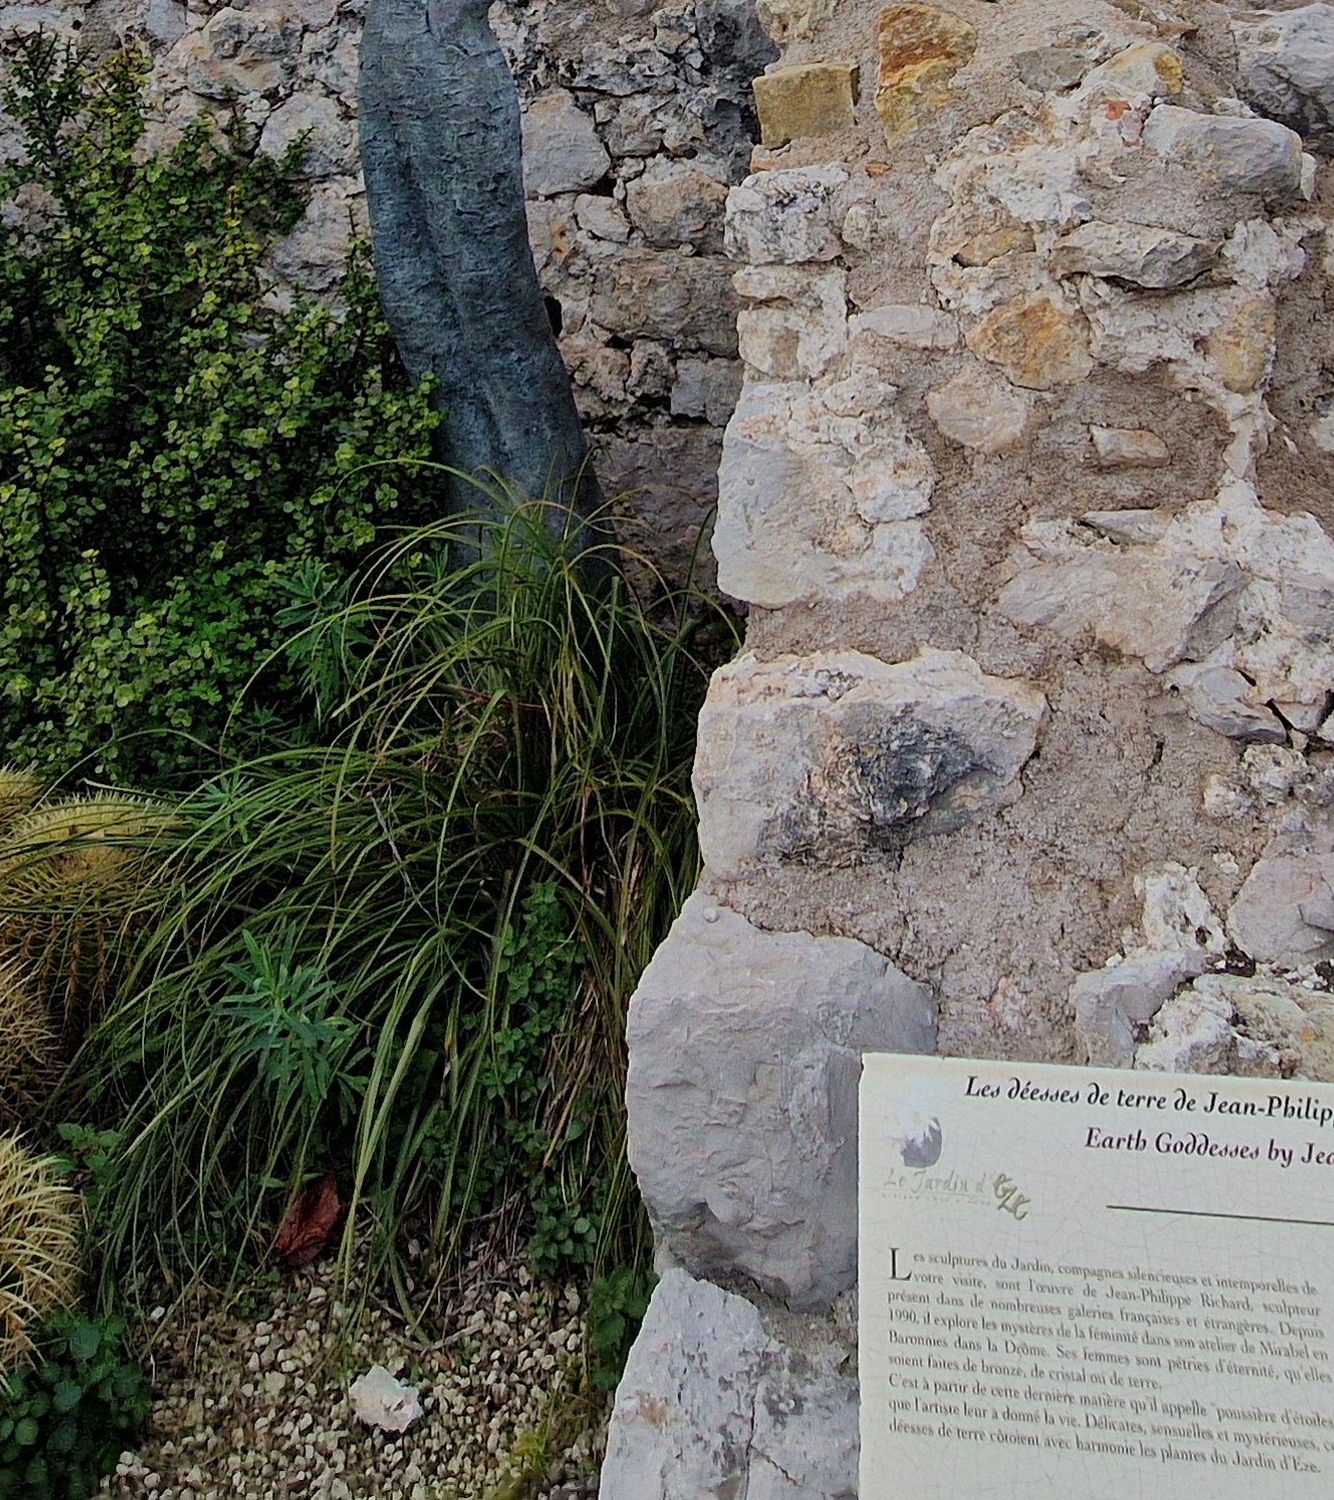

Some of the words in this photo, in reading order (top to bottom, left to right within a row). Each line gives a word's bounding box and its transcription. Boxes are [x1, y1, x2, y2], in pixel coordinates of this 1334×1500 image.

[964, 1076, 1000, 1098] Les
[1007, 1077, 1080, 1104] déesses
[1087, 1082, 1110, 1105] de
[1116, 1089, 1167, 1110] terre
[1173, 1088, 1196, 1112] de
[1085, 1126, 1147, 1152] Earth
[1155, 1131, 1260, 1160] Goddesses
[1268, 1139, 1293, 1169] by
[914, 1273, 944, 1284] votre
[953, 1274, 987, 1289] visite,
[995, 1280, 1020, 1291] sont
[1029, 1279, 1074, 1295] l'œuvre
[1083, 1283, 1097, 1297] de
[1105, 1286, 1191, 1307] Jean-Philippe
[1263, 1301, 1321, 1317] sculpteur
[929, 1252, 987, 1268] sculptures
[992, 1255, 1007, 1269] du
[1011, 1258, 1054, 1273] Jardin,
[1058, 1264, 1124, 1281] compagnes
[1128, 1266, 1197, 1284] silencieuses
[1201, 1276, 1212, 1286] et
[1217, 1274, 1299, 1295] intemporelles
[1301, 1281, 1317, 1296] de
[887, 1290, 930, 1304] présent
[937, 1293, 964, 1307] dans
[970, 1295, 984, 1309] de
[990, 1299, 1061, 1316] nombreuses
[1068, 1304, 1113, 1321] galeries
[1120, 1306, 1180, 1327] françaises
[1187, 1316, 1197, 1327] et
[1279, 1321, 1324, 1340] Depuis
[923, 1311, 931, 1324] il
[934, 1315, 978, 1330] explore
[982, 1316, 997, 1330] les
[1001, 1321, 1053, 1337] mystères
[1057, 1323, 1071, 1338] de
[1074, 1325, 1085, 1339] la
[1089, 1326, 1138, 1343] féminité
[1142, 1331, 1170, 1346] dans
[1174, 1338, 1195, 1348] son
[1199, 1336, 1236, 1352] atelier
[1241, 1339, 1255, 1353] de
[1260, 1341, 1309, 1359] Mirabel
[1313, 1350, 1328, 1360] en
[888, 1354, 923, 1368] soient
[927, 1355, 959, 1371] faites
[963, 1358, 978, 1372] de
[1030, 1363, 1045, 1378] de
[1049, 1367, 1086, 1383] cristal
[1090, 1374, 1106, 1384] ou
[1110, 1371, 1124, 1385] de
[889, 1330, 948, 1347] Baronnies
[954, 1335, 981, 1351] dans
[988, 1338, 998, 1352] la
[1005, 1340, 1050, 1357] Drôme.
[1056, 1344, 1077, 1360] Ses
[1083, 1347, 1130, 1365] femmes
[1135, 1356, 1161, 1368] sont
[1167, 1355, 1210, 1373] pétries
[1216, 1357, 1278, 1380] d'éternité,
[1284, 1365, 1332, 1384] qu'elles
[889, 1373, 918, 1389] C'est
[923, 1377, 930, 1391] à
[934, 1381, 968, 1395] partir
[972, 1380, 987, 1395] de
[991, 1384, 1020, 1399] cette
[1024, 1386, 1075, 1404] dernière
[1080, 1392, 1125, 1409] matière
[1130, 1397, 1158, 1413] qu'il
[1162, 1400, 1207, 1419] appelle
[889, 1401, 911, 1413] que
[915, 1397, 960, 1416] l'artiste
[964, 1402, 987, 1418] leur
[1002, 1406, 1040, 1423] donné
[1044, 1409, 1055, 1425] la
[1085, 1414, 1147, 1435] Délicates,
[1151, 1420, 1214, 1441] sensuelles
[1218, 1430, 1229, 1441] et
[1234, 1430, 1320, 1452] mystérieuses,
[889, 1418, 934, 1436] déesses
[937, 1422, 953, 1438] de
[956, 1427, 986, 1440] terre
[989, 1429, 1040, 1447] côtoient
[1043, 1437, 1071, 1449] avec
[1076, 1434, 1135, 1456] harmonie
[1140, 1441, 1157, 1458] les
[1161, 1444, 1207, 1463] plantes
[1210, 1448, 1227, 1464] du
[1232, 1451, 1276, 1470] Jardin
